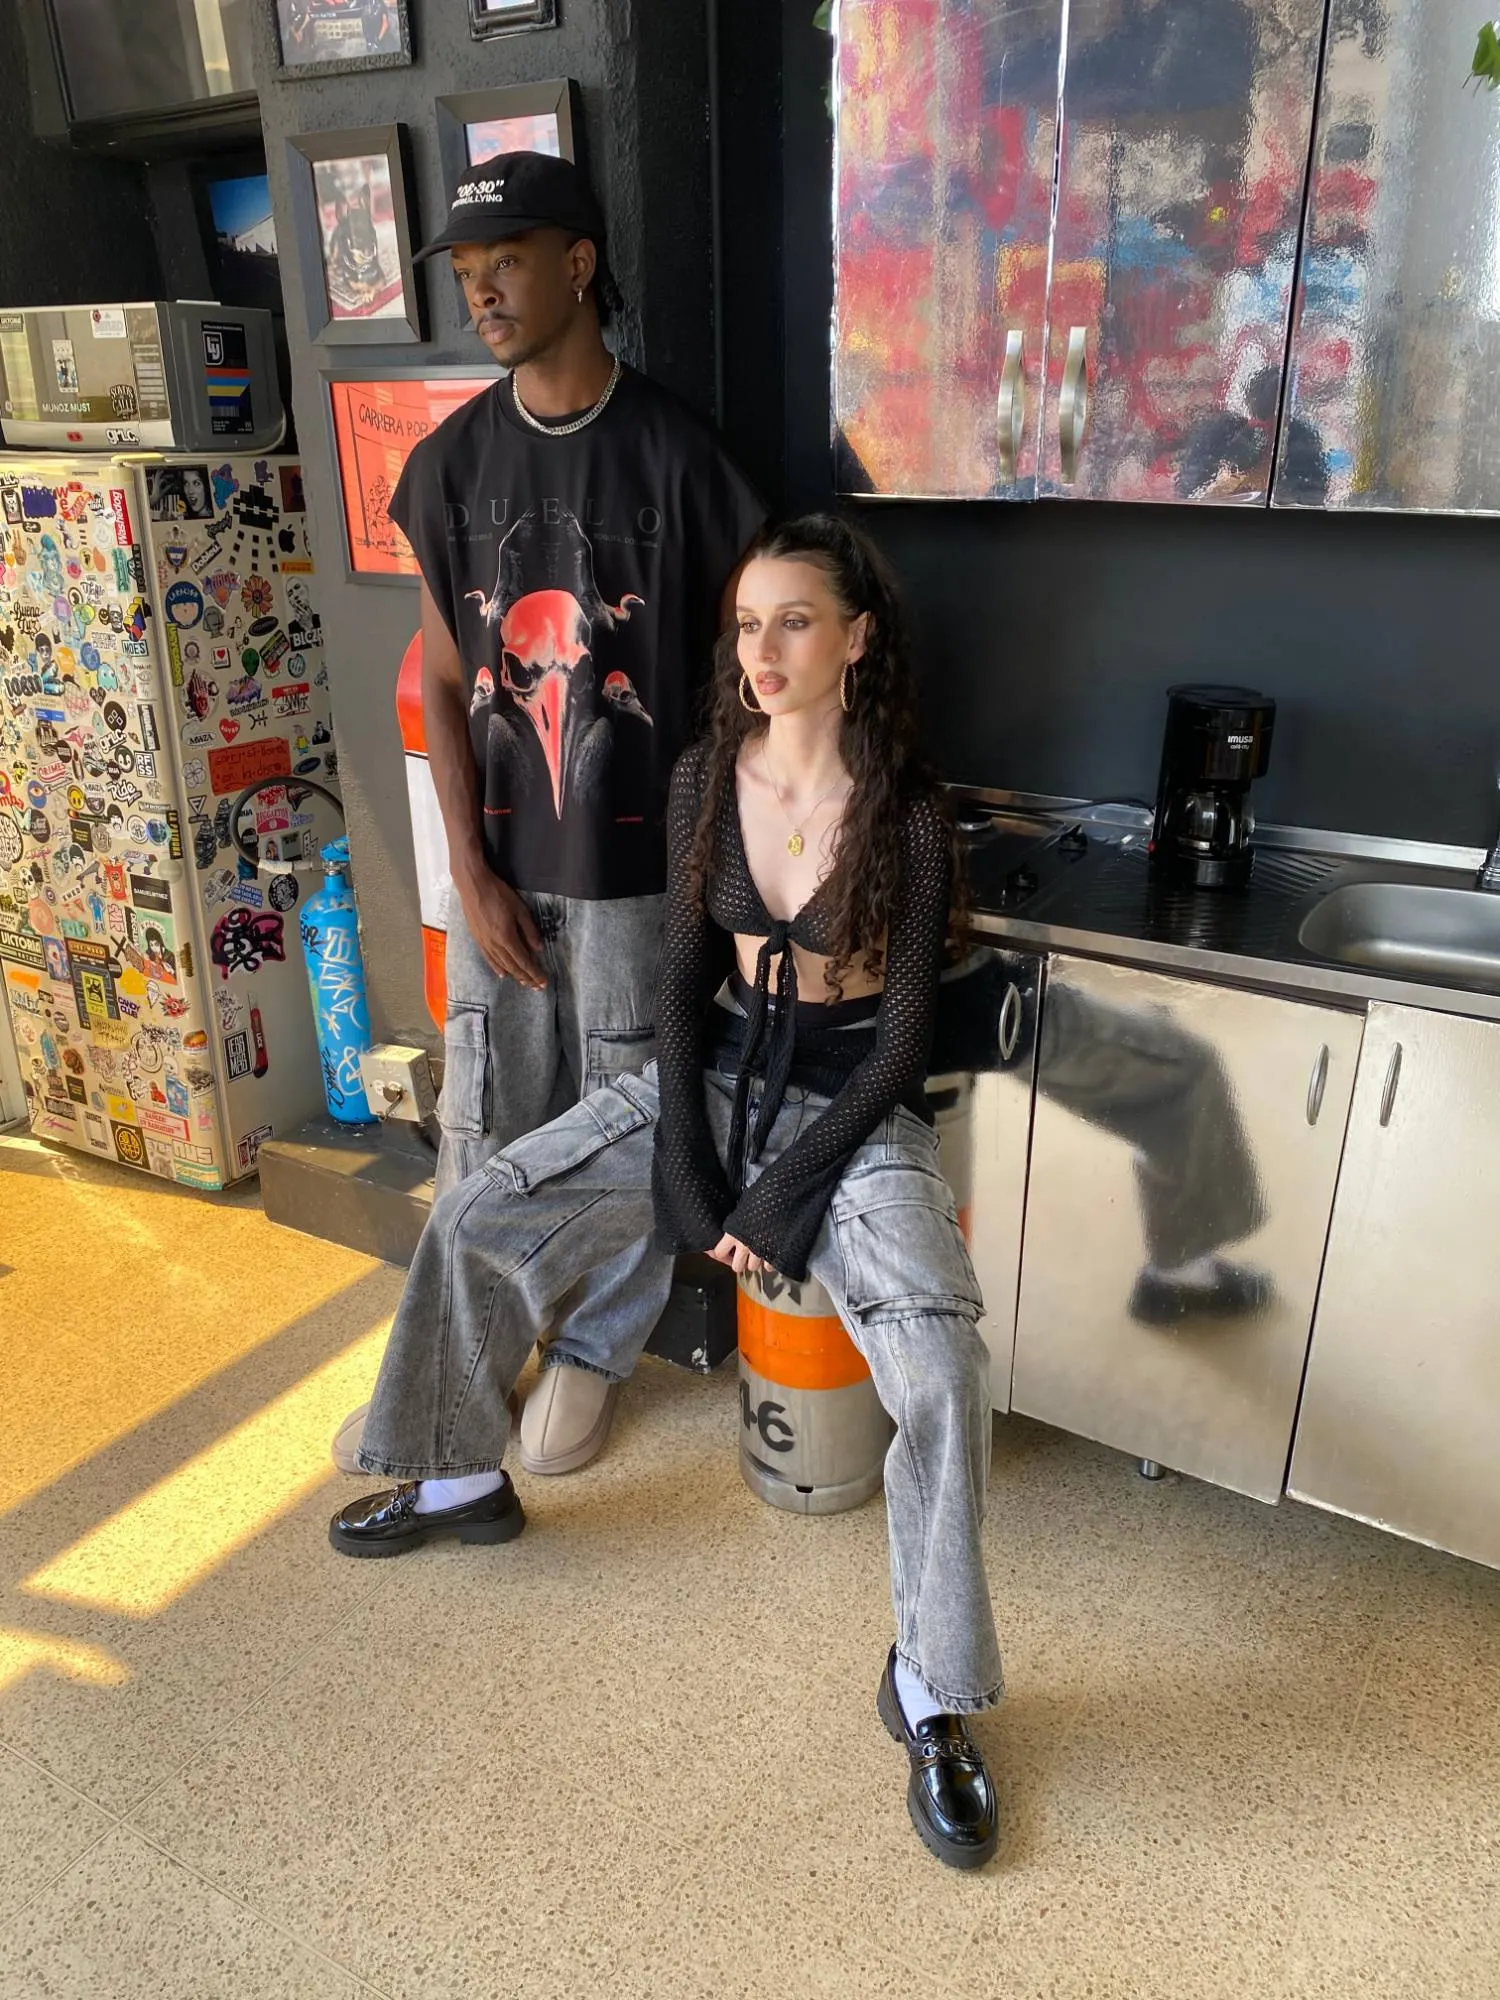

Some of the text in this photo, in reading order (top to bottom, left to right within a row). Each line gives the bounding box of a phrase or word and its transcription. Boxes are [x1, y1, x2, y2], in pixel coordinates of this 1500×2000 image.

[358, 403, 405, 437] CARRERA
[112, 490, 128, 546] Washedog
[138, 765, 153, 776] SS
[118, 996, 140, 1012] CANDY
